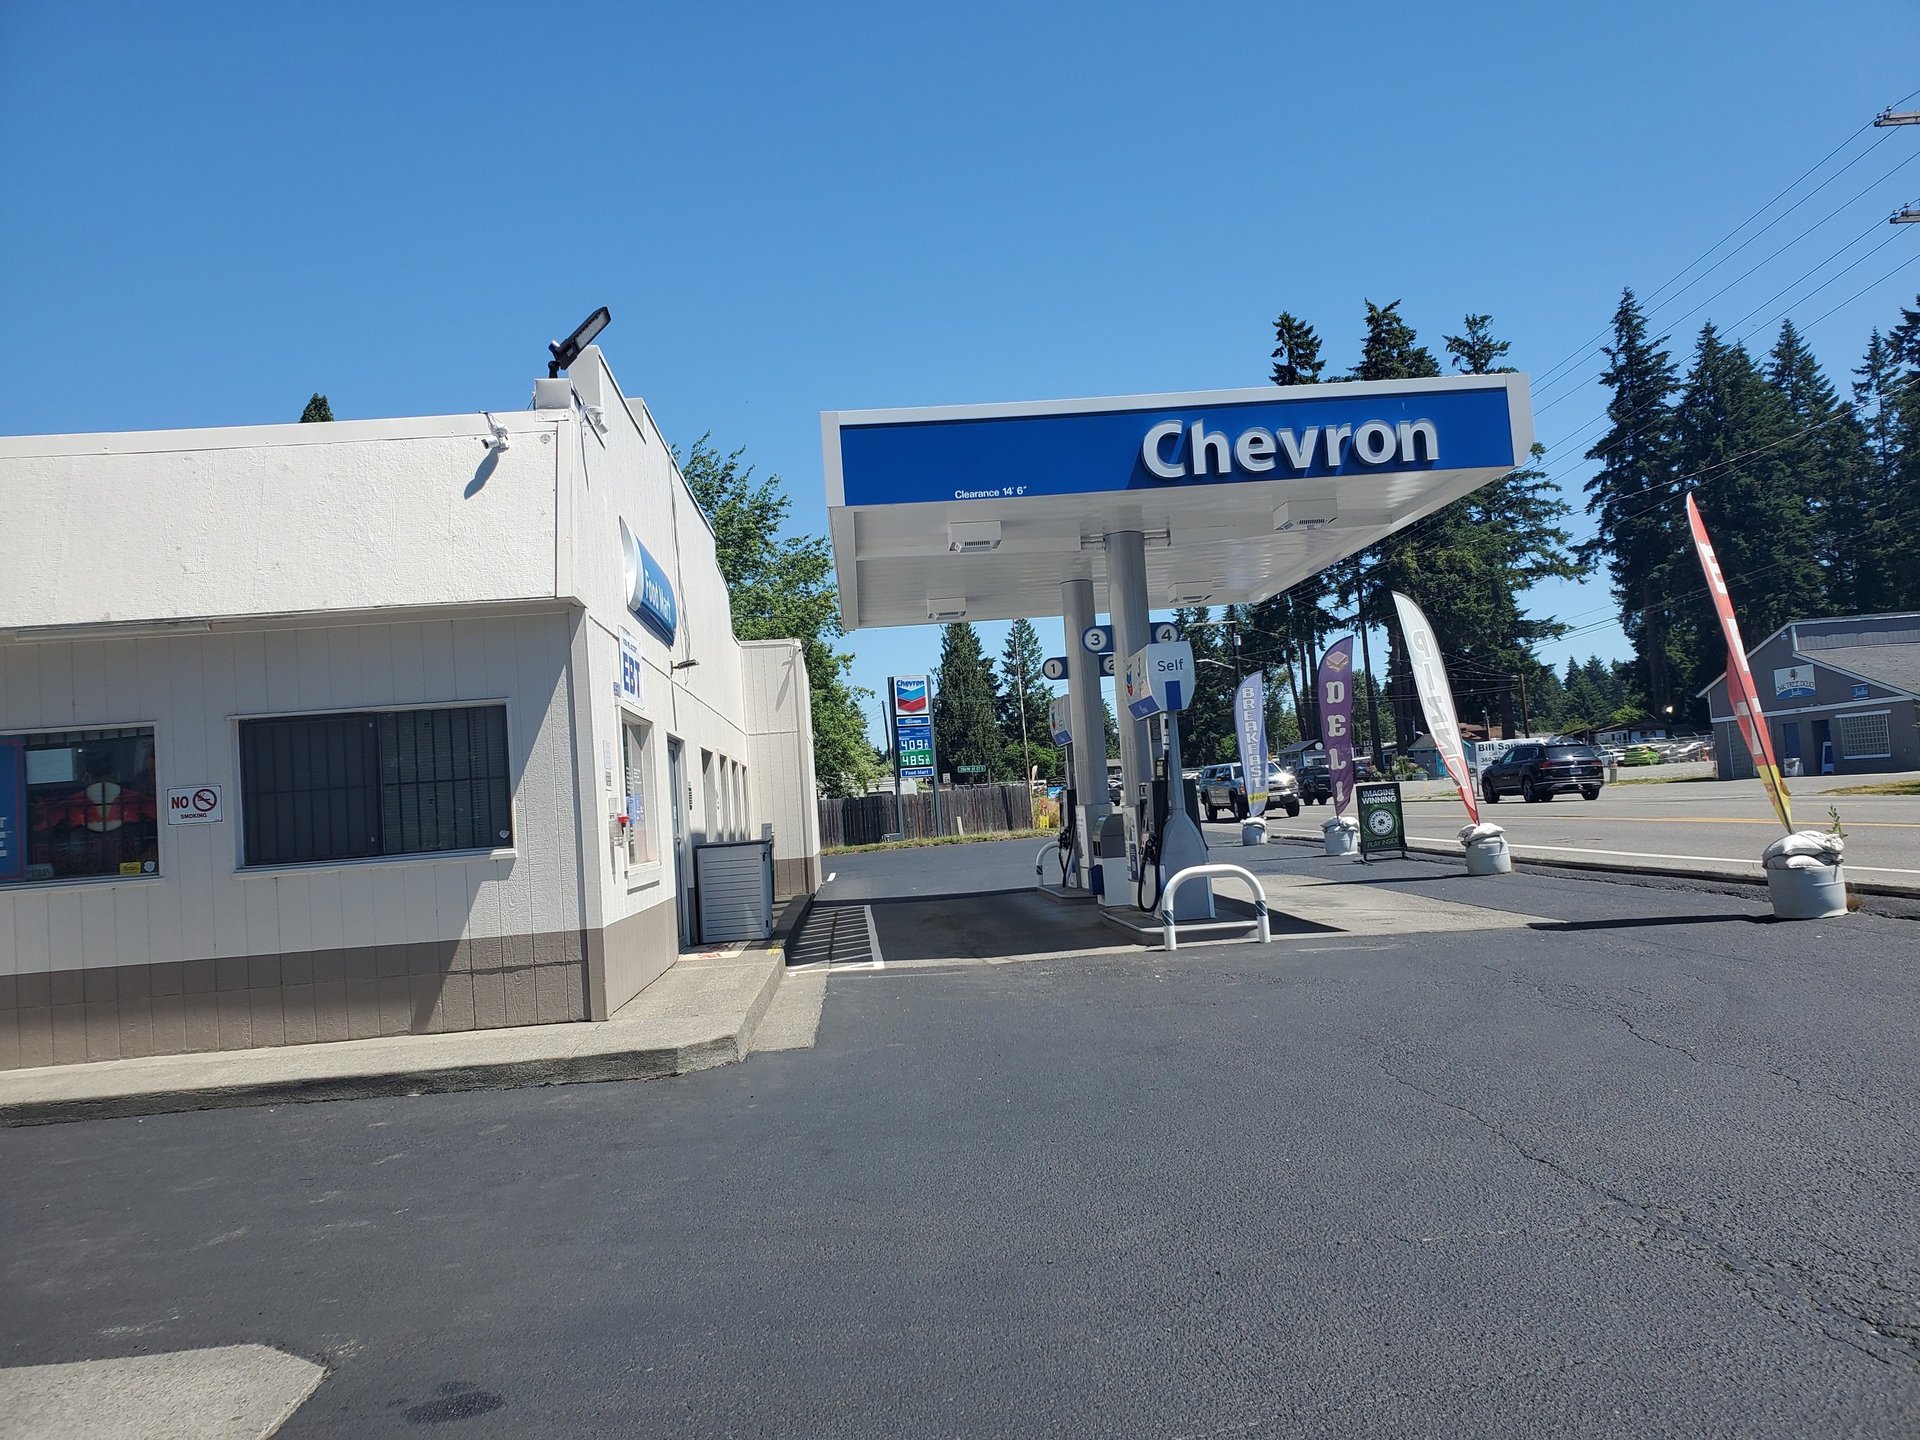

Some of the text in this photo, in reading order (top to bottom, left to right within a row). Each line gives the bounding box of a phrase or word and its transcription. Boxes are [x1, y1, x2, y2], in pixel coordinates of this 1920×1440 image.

[1142, 418, 1440, 480] Chevron
[954, 488, 1000, 499] Clearance
[1090, 633, 1101, 646] 3
[1161, 629, 1172, 641] 4
[1050, 663, 1056, 674] 1
[1157, 658, 1184, 672] Self
[622, 651, 641, 698] EBT
[896, 680, 925, 688] Chevron
[1789, 688, 1803, 698] Judo
[1854, 687, 1869, 698] Judo
[1242, 687, 1262, 788] BREAKFAST
[1326, 681, 1347, 801] DELI
[1478, 743, 1494, 752] Bill
[1362, 788, 1396, 798] IMAGINE
[171, 795, 189, 810] NO
[1361, 795, 1397, 805] WINNING
[180, 812, 208, 820] SMOKING
[1380, 837, 1400, 846] INSIDE
